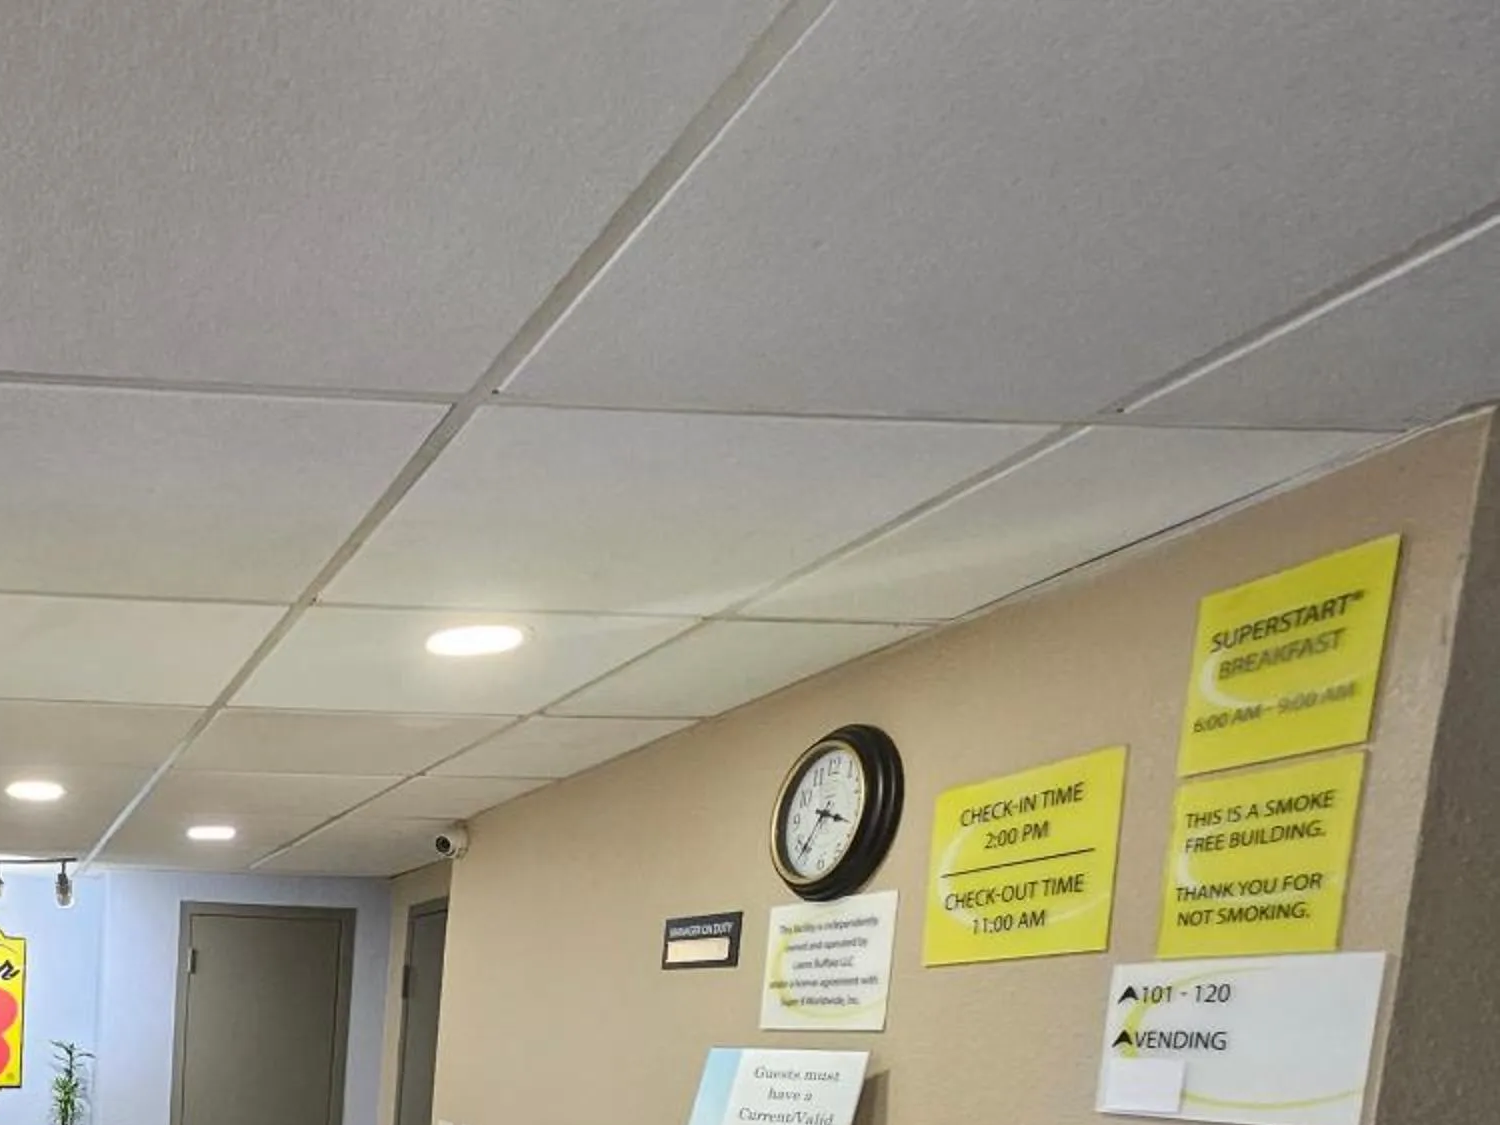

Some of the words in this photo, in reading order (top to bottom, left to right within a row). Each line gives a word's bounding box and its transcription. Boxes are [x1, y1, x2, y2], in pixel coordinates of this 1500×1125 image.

[1217, 627, 1347, 680] BREAKFAST
[1193, 712, 1228, 733] 6:00
[1231, 704, 1262, 725] AM
[1320, 682, 1357, 703] AM
[813, 767, 825, 787] 11
[960, 794, 1036, 827] CHECK-IN
[1041, 781, 1085, 809] TIME
[1185, 809, 1221, 829] THIS
[1227, 805, 1243, 823] IS
[1245, 804, 1259, 819] A
[1264, 789, 1337, 817] SMOKE
[984, 827, 1017, 849] 2:00
[1022, 820, 1049, 842] PM
[1185, 833, 1225, 853] FREE
[1229, 820, 1326, 848] BUILDING.
[945, 881, 1038, 911] CHECK-OUT
[1042, 873, 1085, 897] TIME
[1176, 882, 1234, 902] THANK
[1238, 877, 1278, 896] YOU
[1282, 872, 1323, 892] FOR
[972, 914, 1012, 935] 11:00
[1018, 910, 1046, 929] AM
[1177, 909, 1214, 927] NOT
[1216, 902, 1311, 925] SMOKING.
[1142, 984, 1172, 1004] 101
[1195, 983, 1231, 1003] 120
[1135, 1031, 1228, 1050] VENDING
[754, 1066, 800, 1080] Guests
[804, 1070, 840, 1082] must
[767, 1088, 800, 1101] have
[803, 1093, 812, 1101] a
